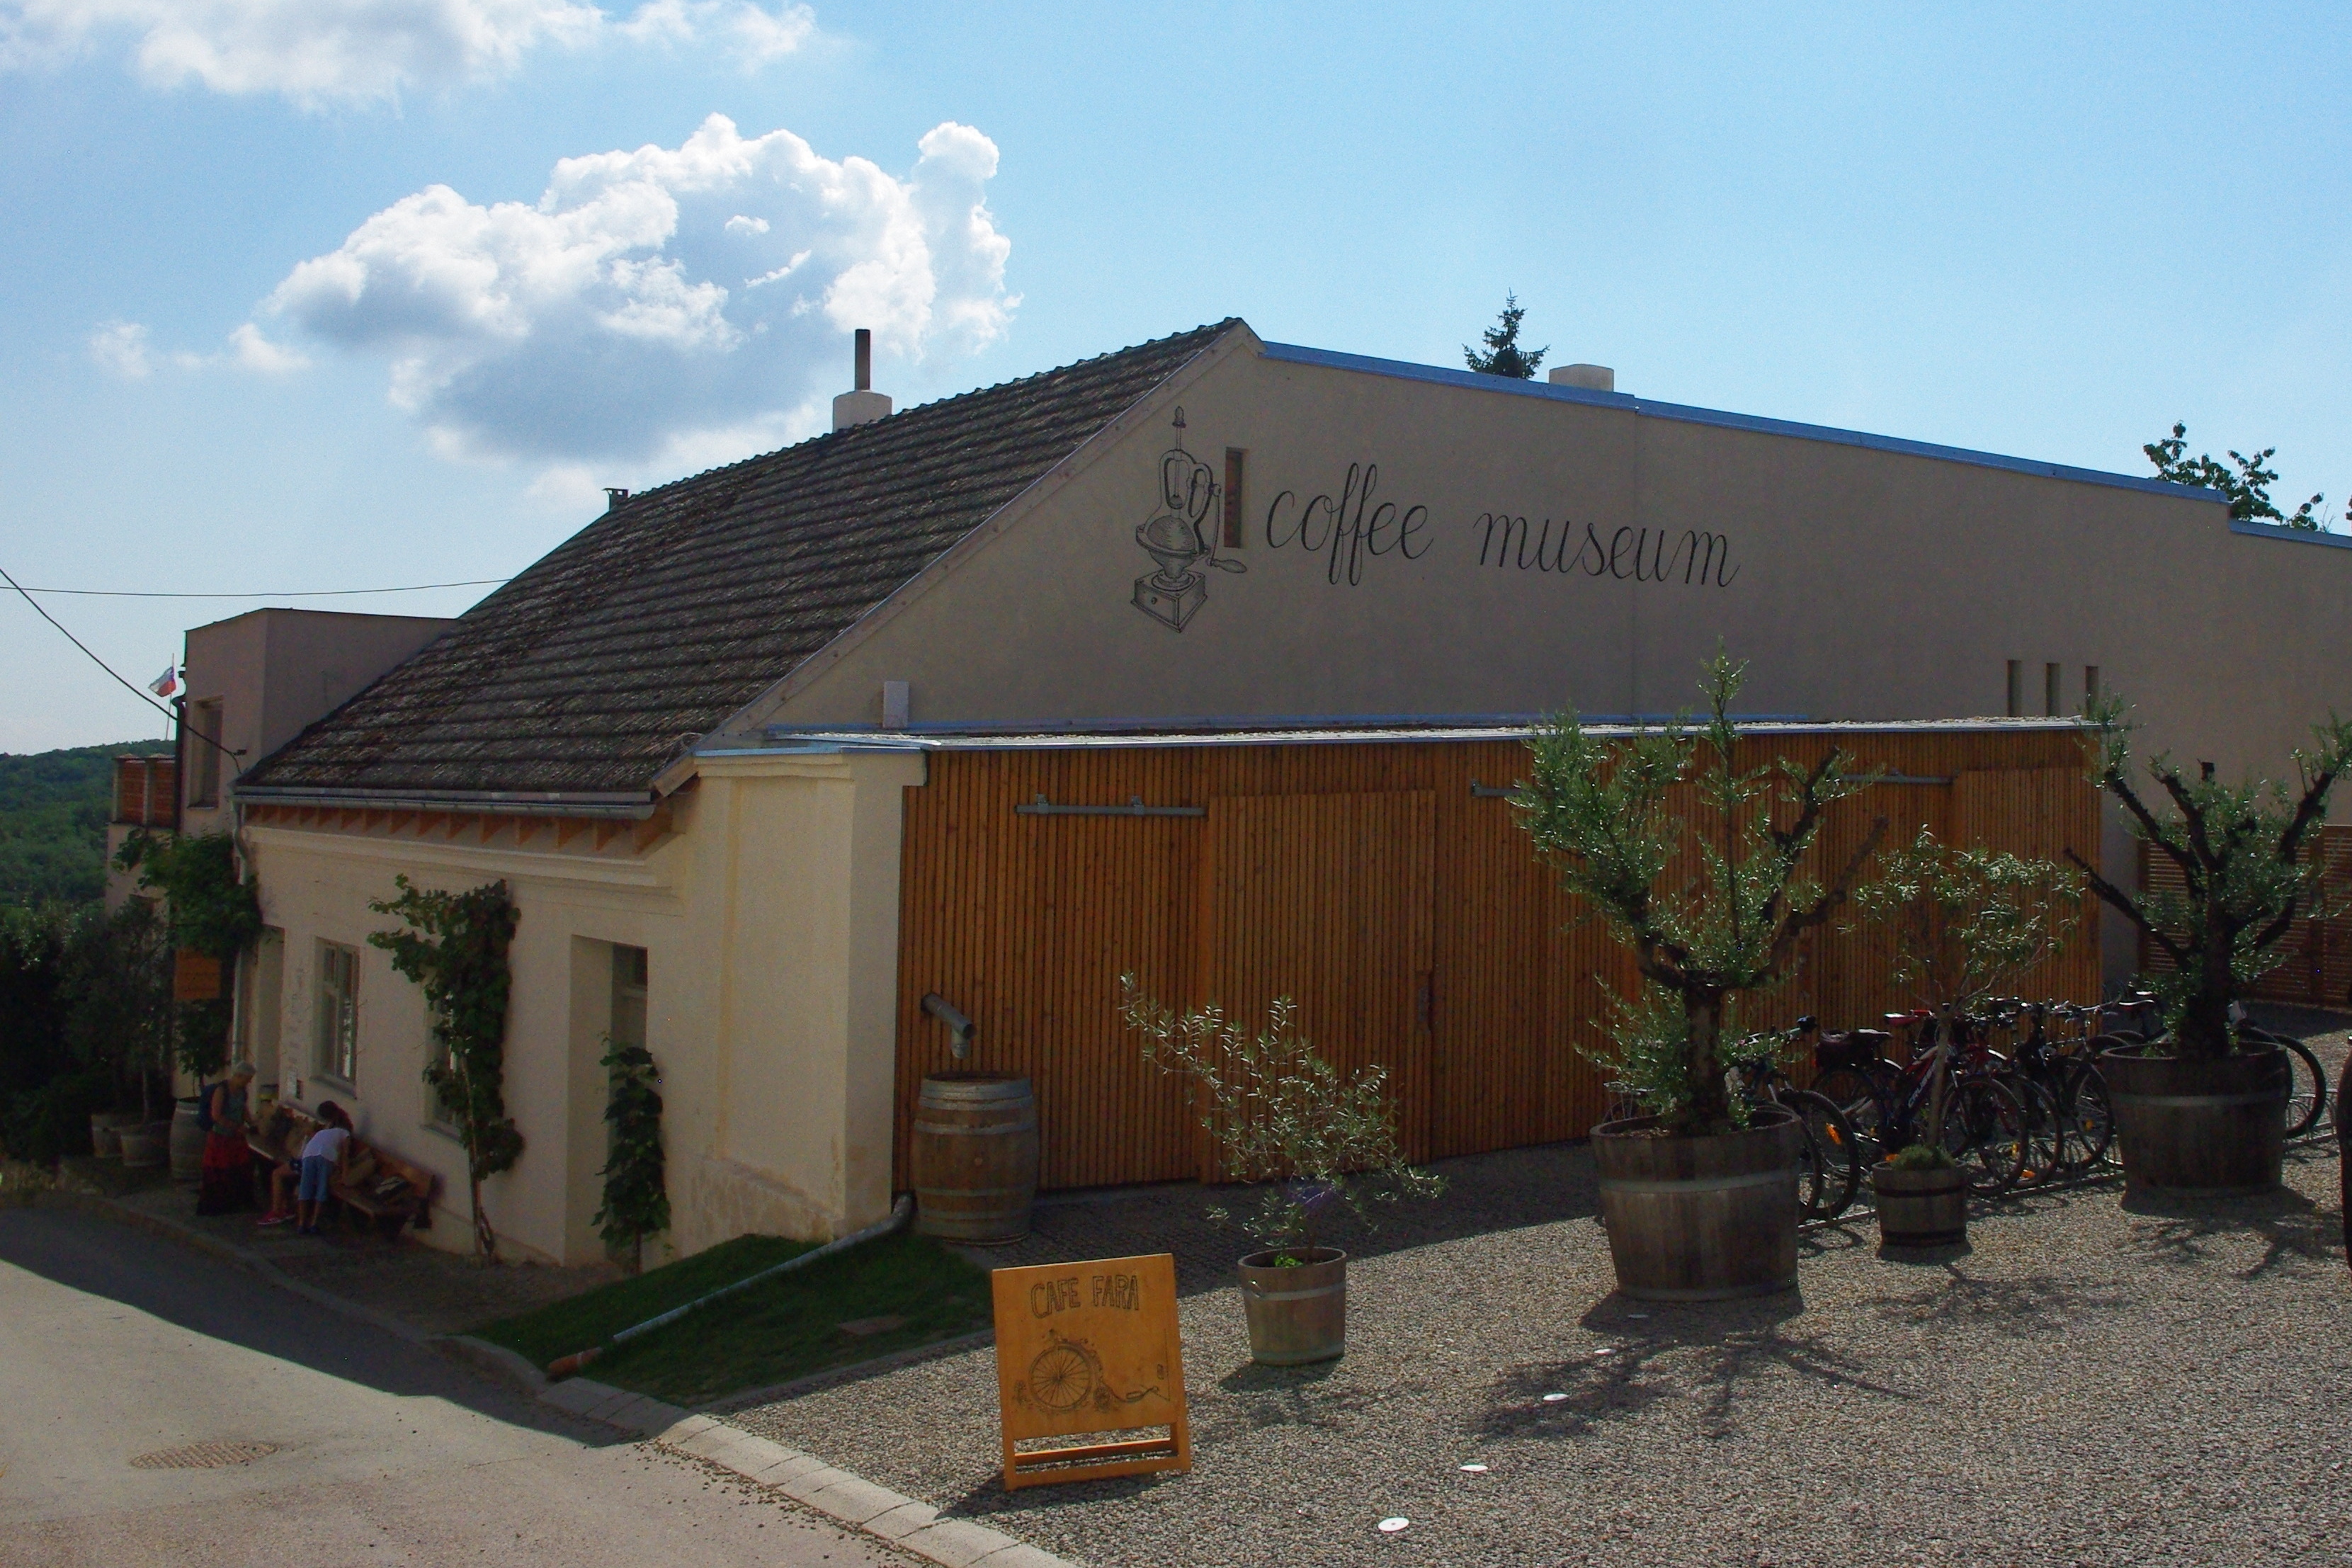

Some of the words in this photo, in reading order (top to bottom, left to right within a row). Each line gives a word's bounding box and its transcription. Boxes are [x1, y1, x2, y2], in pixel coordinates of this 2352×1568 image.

[1266, 462, 1434, 586] coffee
[1472, 513, 1741, 587] museum
[1030, 1277, 1081, 1319] CAFE
[1092, 1275, 1140, 1310] FARA
